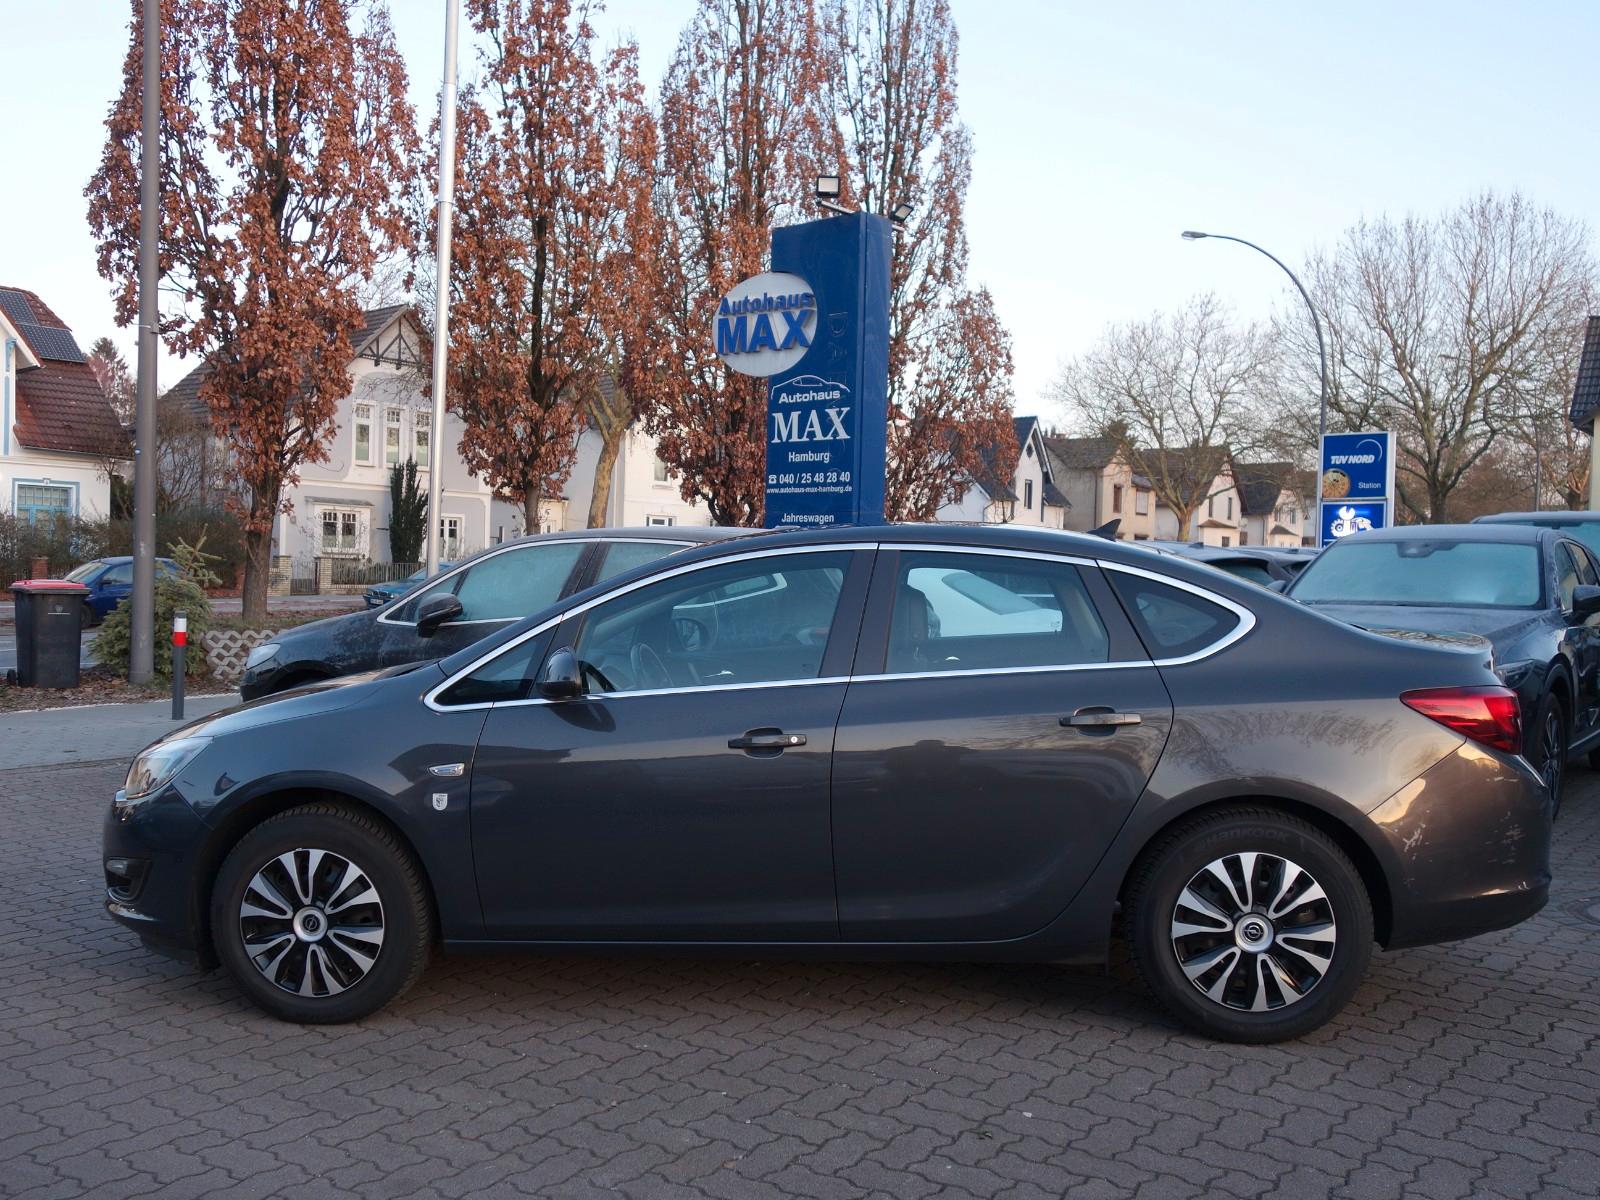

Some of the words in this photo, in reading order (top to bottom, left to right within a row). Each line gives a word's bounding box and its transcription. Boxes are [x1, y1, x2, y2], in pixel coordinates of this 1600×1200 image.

[718, 291, 816, 316] Autohaus
[718, 308, 812, 355] MAX
[779, 390, 840, 404] Autohaus
[771, 407, 851, 443] MAX
[788, 451, 830, 463] Hamburg
[1348, 454, 1375, 464] NORD
[779, 473, 794, 484] 040
[801, 472, 812, 484] 25
[813, 472, 824, 484] 48
[826, 471, 837, 483] 28
[839, 471, 851, 483] 40
[766, 484, 853, 494] www.autohaus-max-hamburg.de
[1358, 481, 1381, 489] Station
[781, 512, 835, 525] Jahreswagen
